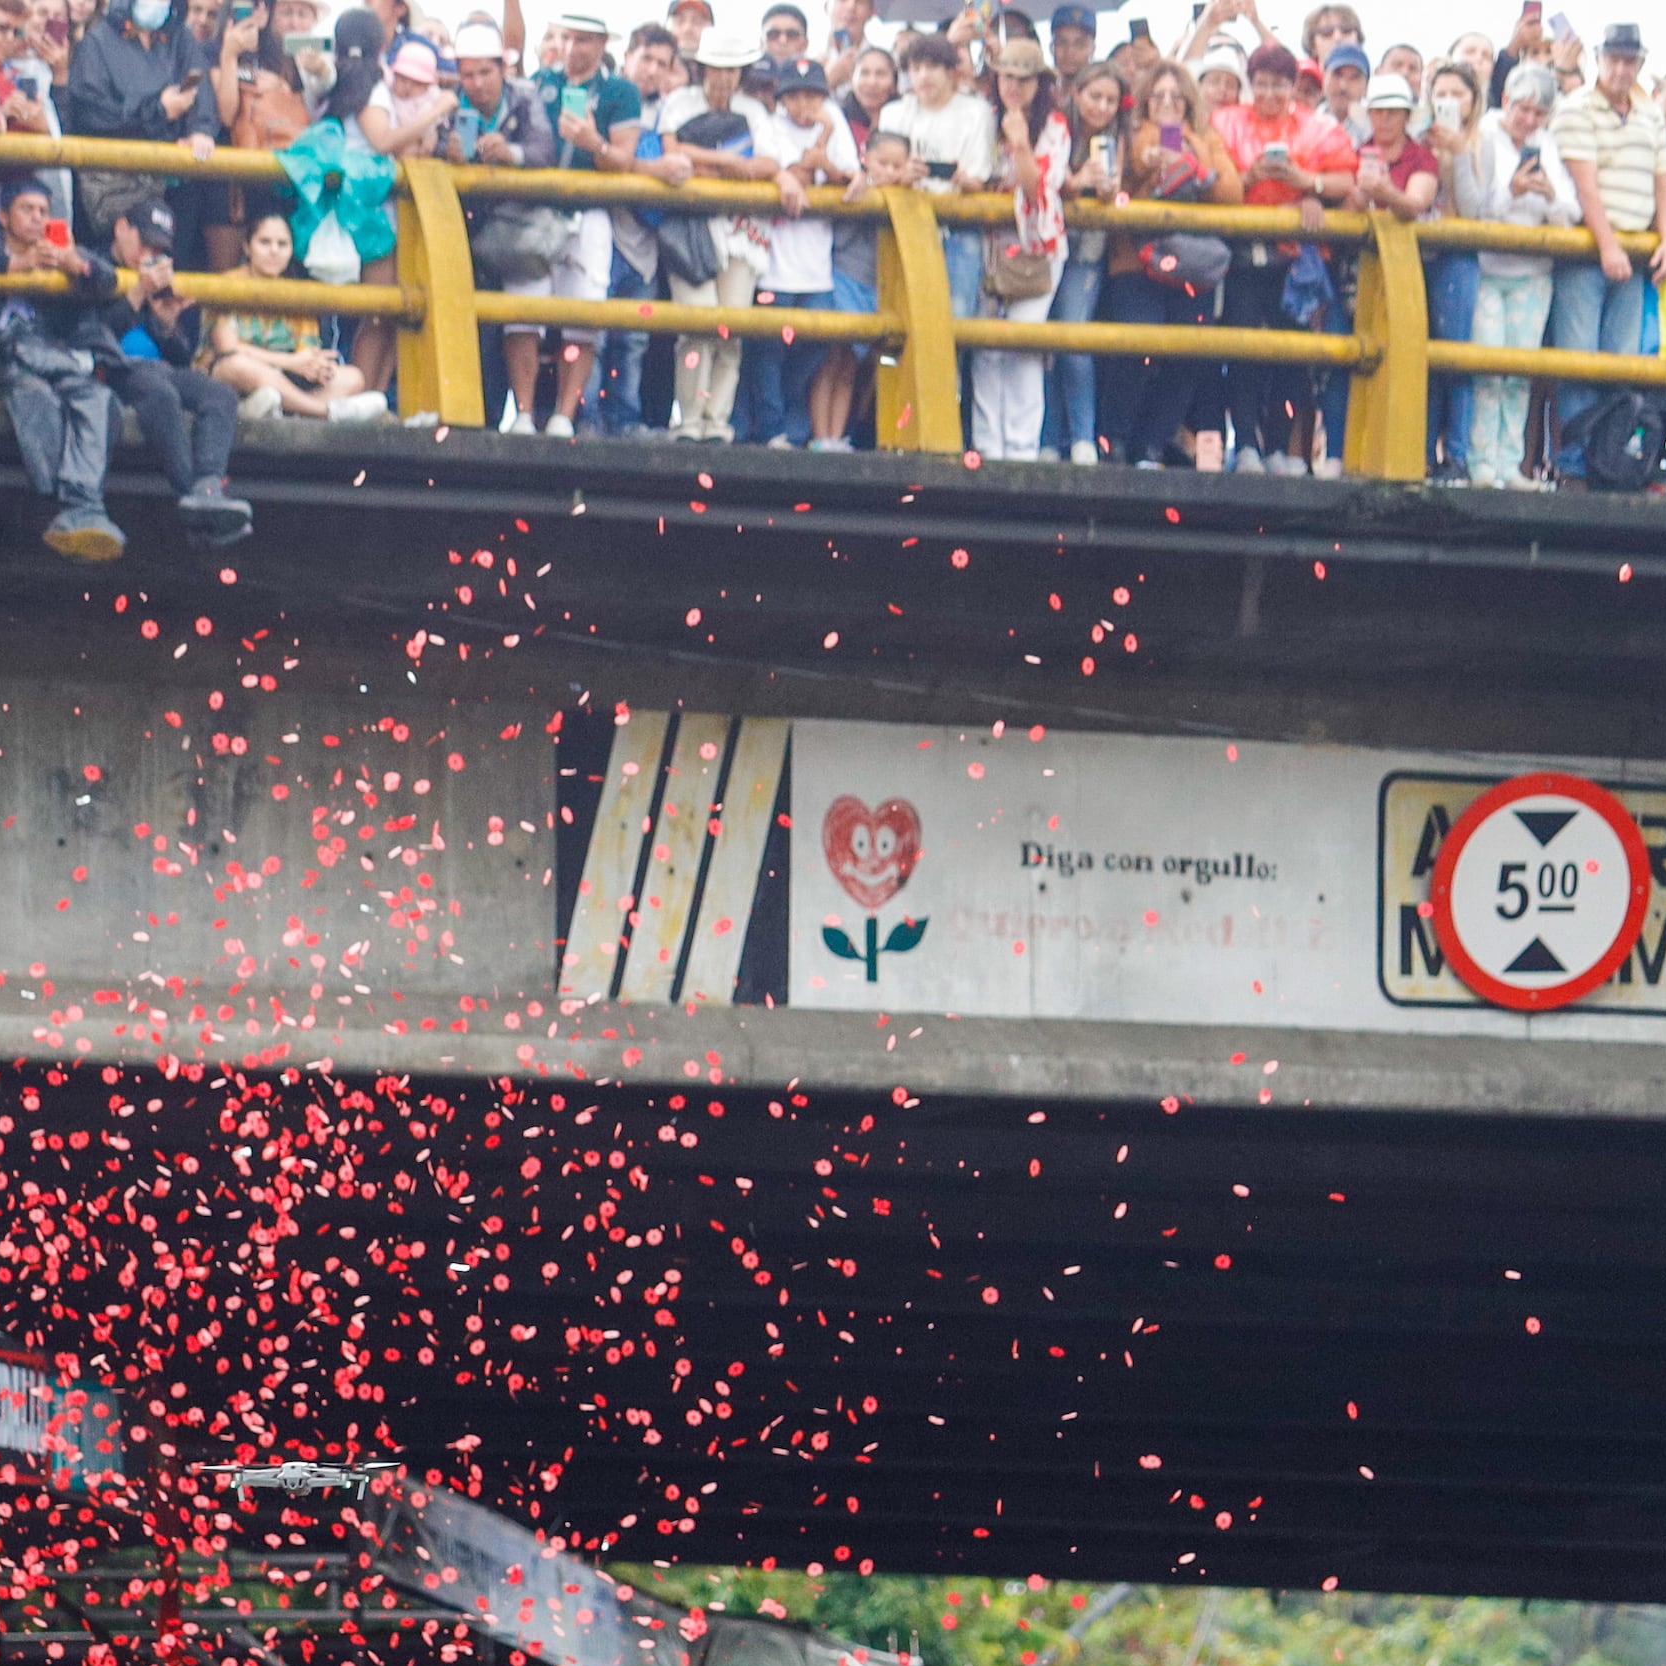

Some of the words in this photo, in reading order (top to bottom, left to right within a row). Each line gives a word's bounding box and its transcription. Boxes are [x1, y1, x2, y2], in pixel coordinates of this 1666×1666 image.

[1019, 841, 1094, 878] Diga
[1103, 850, 1154, 874] con
[1161, 852, 1278, 886] orgullo:
